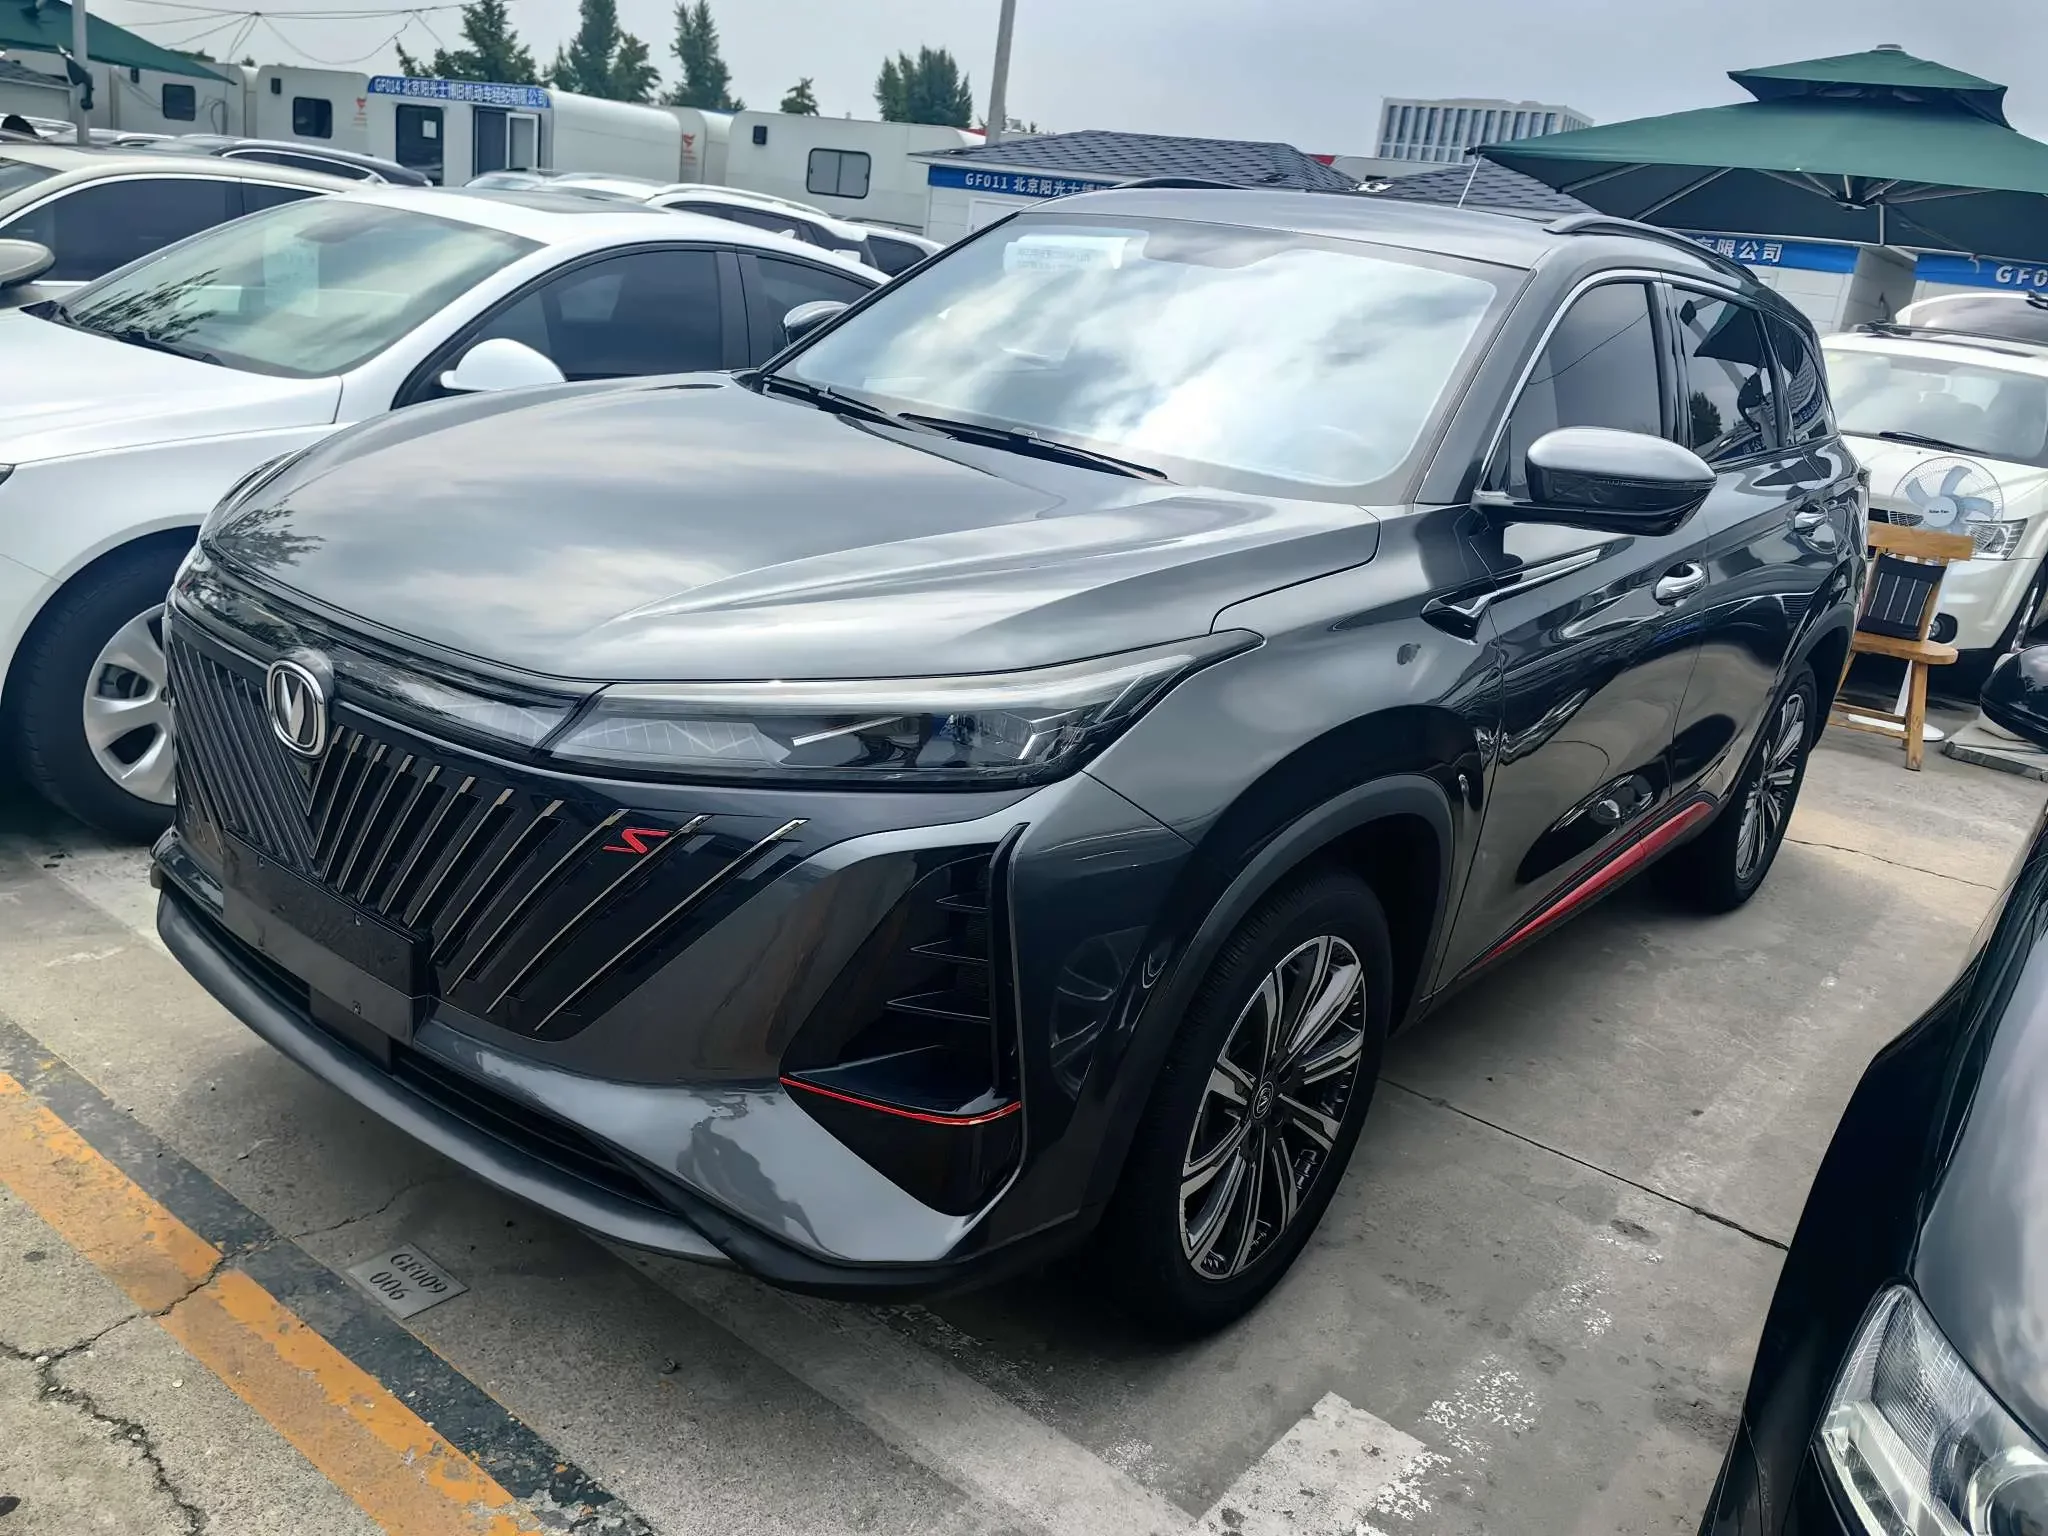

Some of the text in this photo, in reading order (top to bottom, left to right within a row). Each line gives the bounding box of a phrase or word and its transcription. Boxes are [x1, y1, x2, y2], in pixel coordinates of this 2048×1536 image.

[965, 173, 1008, 189] GF011
[369, 1271, 413, 1300] 006
[390, 1253, 448, 1293] GF009
